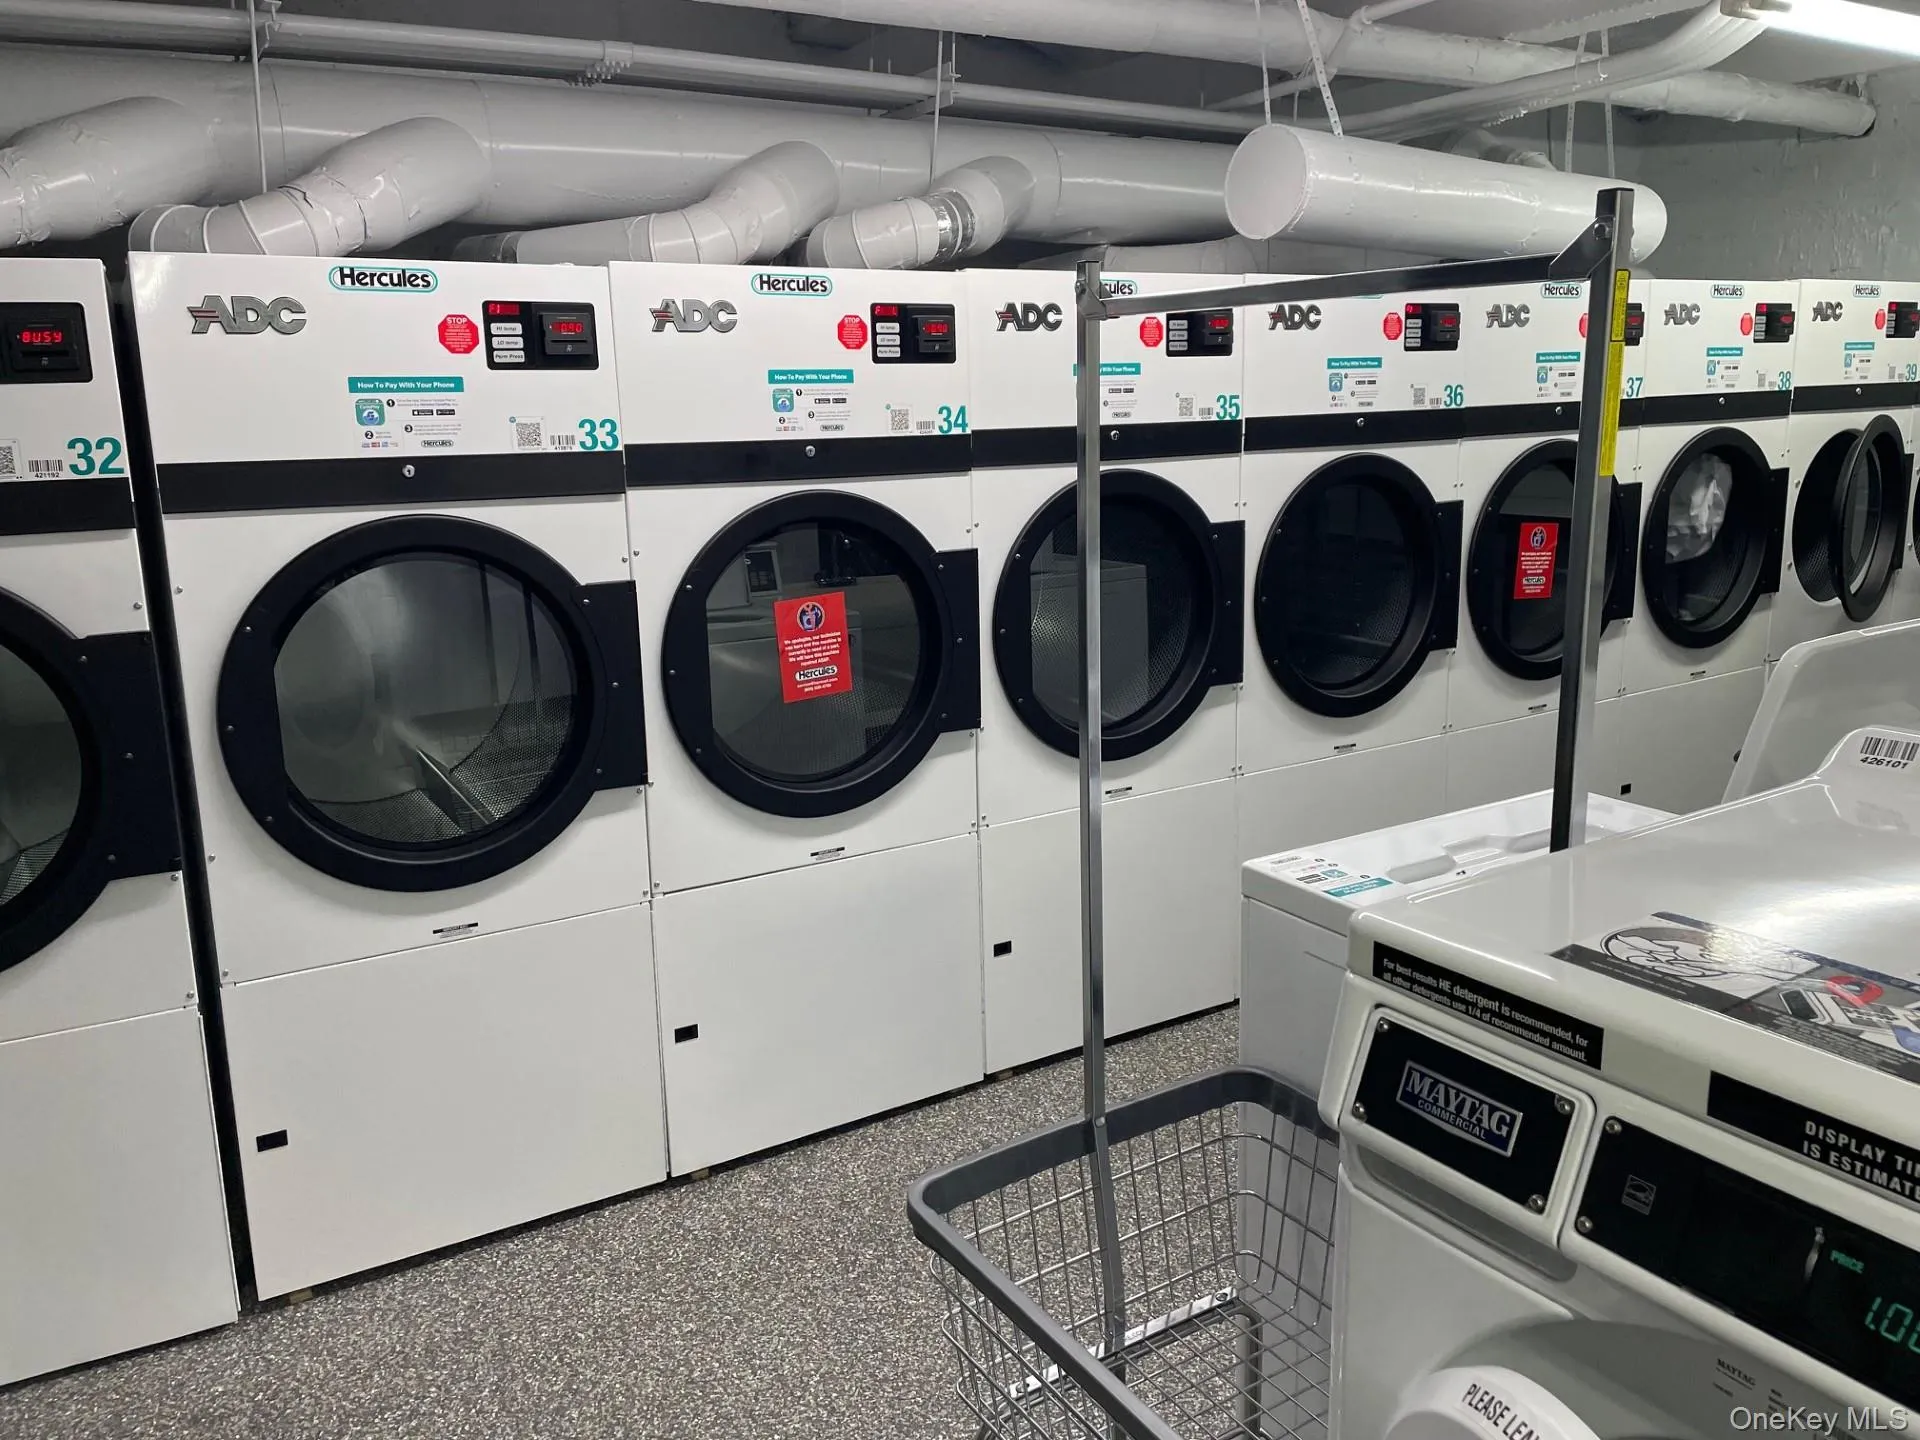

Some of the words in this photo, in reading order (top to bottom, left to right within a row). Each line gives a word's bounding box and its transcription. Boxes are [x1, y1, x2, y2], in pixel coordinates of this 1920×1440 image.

[339, 267, 431, 288] Hercules
[759, 274, 828, 293] Hercules
[1544, 284, 1579, 296] Hercules
[1713, 286, 1743, 297] Hercules
[1855, 285, 1880, 296] Hercules
[187, 295, 307, 335] ADC
[649, 299, 738, 334] ADC
[844, 316, 860, 324] STOP
[995, 302, 1063, 332] ADC
[1268, 304, 1322, 331] ADC
[1486, 304, 1530, 328] ADC
[1664, 303, 1701, 326] ADC
[1812, 301, 1844, 322] ADC
[22, 331, 63, 343] BUSY
[1778, 371, 1792, 390] 38
[1905, 364, 1918, 381] 39
[385, 382, 398, 390] Pay
[433, 381, 455, 389] Phone
[1444, 385, 1464, 407] 36
[1626, 377, 1644, 398] 37
[938, 405, 969, 434] 34
[1216, 395, 1241, 421] 35
[578, 418, 620, 451] 33
[67, 437, 125, 476] 32
[799, 667, 836, 680] Hercules
[1860, 756, 1909, 769] 426101
[1383, 959, 1395, 970] For
[1396, 963, 1412, 977] best
[1413, 971, 1438, 988] results
[1439, 978, 1453, 993] HE
[1453, 985, 1500, 1013] detergent
[1501, 1002, 1511, 1017] is
[1511, 1011, 1574, 1044] recommended,
[1576, 1034, 1589, 1047] for
[1383, 972, 1392, 982] all
[1393, 976, 1411, 989] other
[1412, 984, 1452, 1007] detergents
[1452, 1000, 1466, 1013] use
[1468, 1005, 1481, 1018] 1/4
[1482, 1012, 1491, 1022] of
[1491, 1017, 1550, 1047] recommended
[1552, 1040, 1587, 1062] amount.
[1406, 1070, 1511, 1138] MAYTAG
[1417, 1099, 1487, 1140] COMMERCIAL
[1802, 1140, 1822, 1159] IS
[1805, 1120, 1887, 1164] DISPLAY
[1830, 1249, 1865, 1274] PRICE
[1717, 1358, 1757, 1386] MAYTAG
[1462, 1383, 1511, 1428] PLEASE
